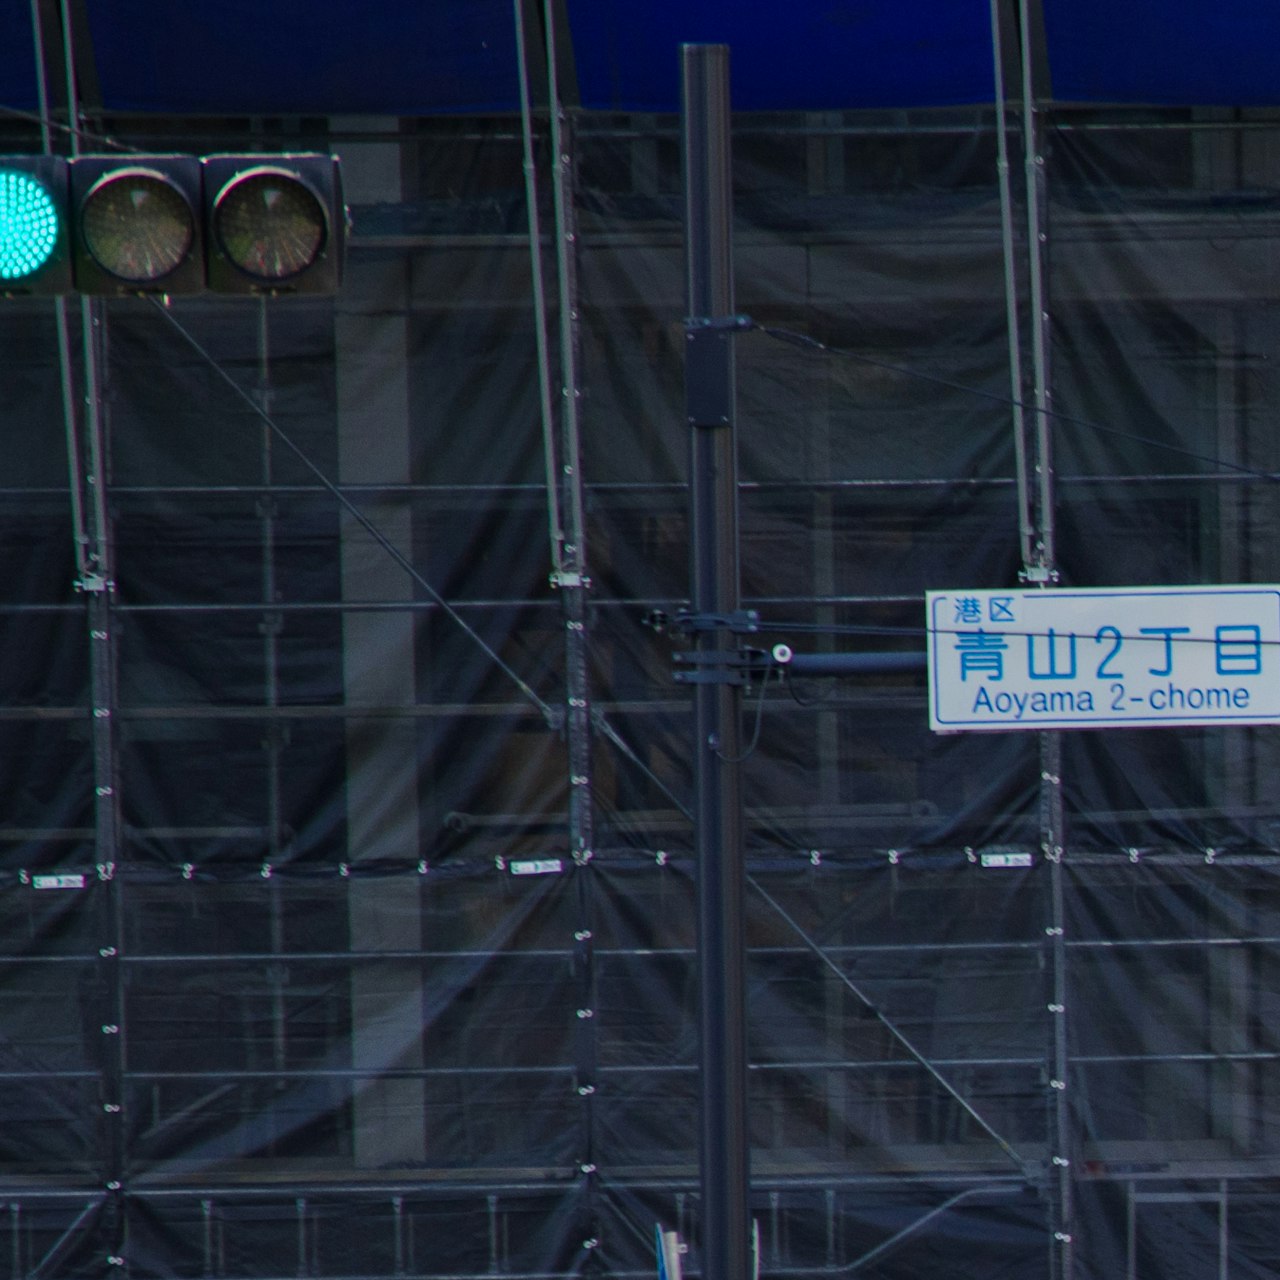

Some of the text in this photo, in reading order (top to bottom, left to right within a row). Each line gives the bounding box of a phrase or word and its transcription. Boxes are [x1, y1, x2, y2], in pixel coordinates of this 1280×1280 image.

[953, 596, 1016, 624] 港区
[953, 625, 1262, 683] 青山2丁目
[972, 682, 1251, 719] Aoyama 2-chome
